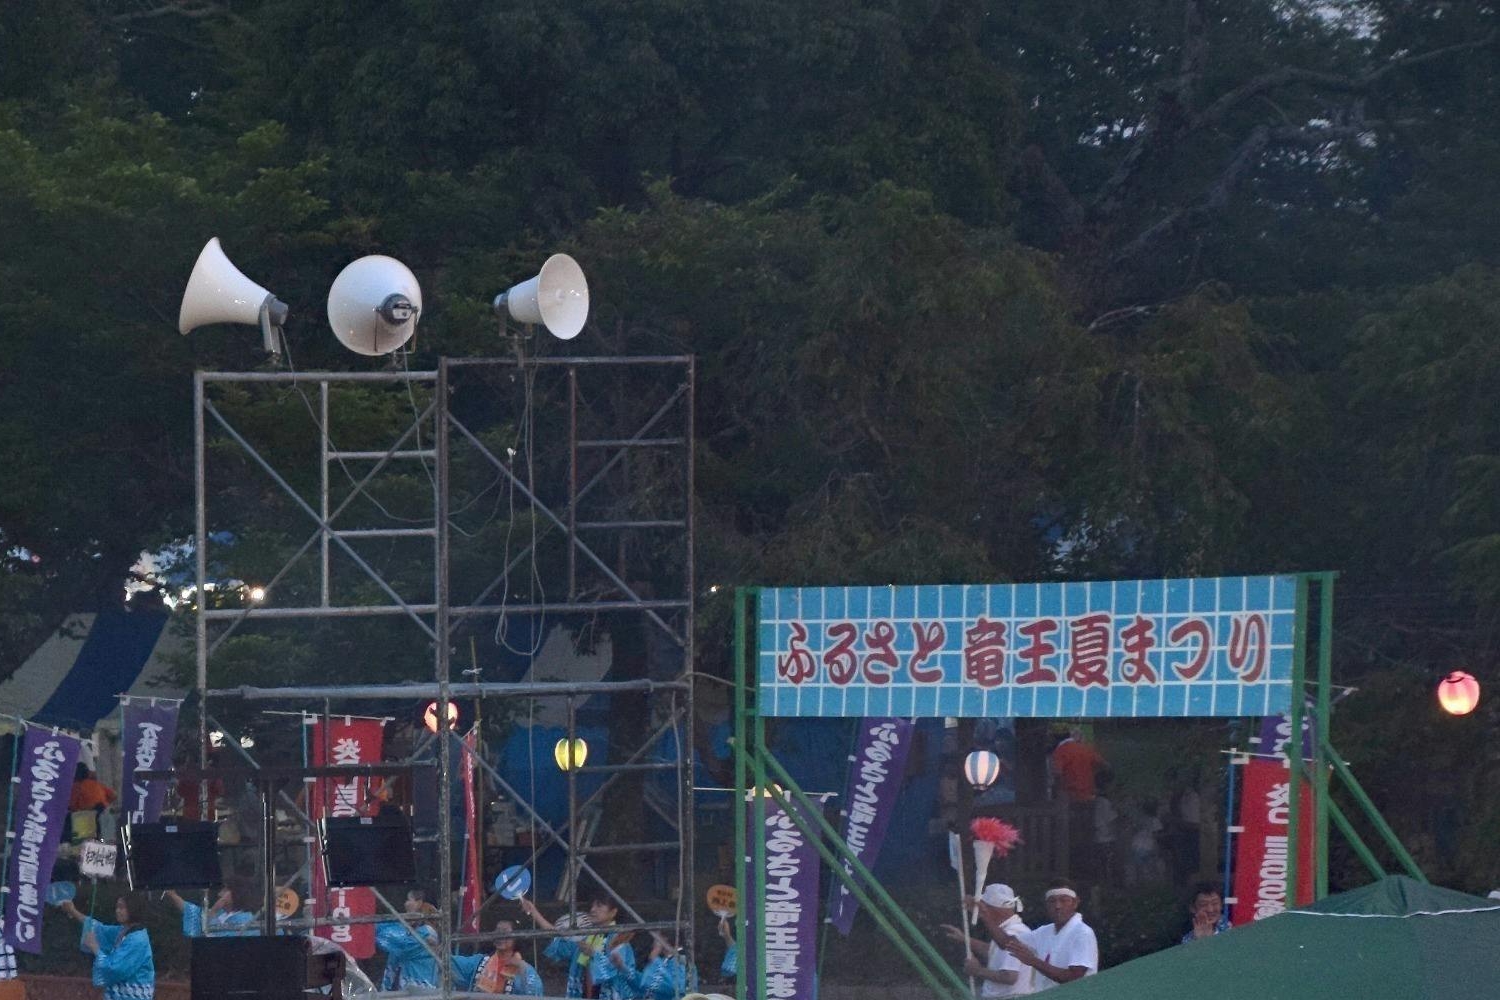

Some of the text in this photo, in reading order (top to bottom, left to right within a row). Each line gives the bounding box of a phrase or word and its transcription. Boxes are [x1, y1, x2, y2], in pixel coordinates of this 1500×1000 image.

[777, 611, 1273, 690] ふるさと竜王夏まつり
